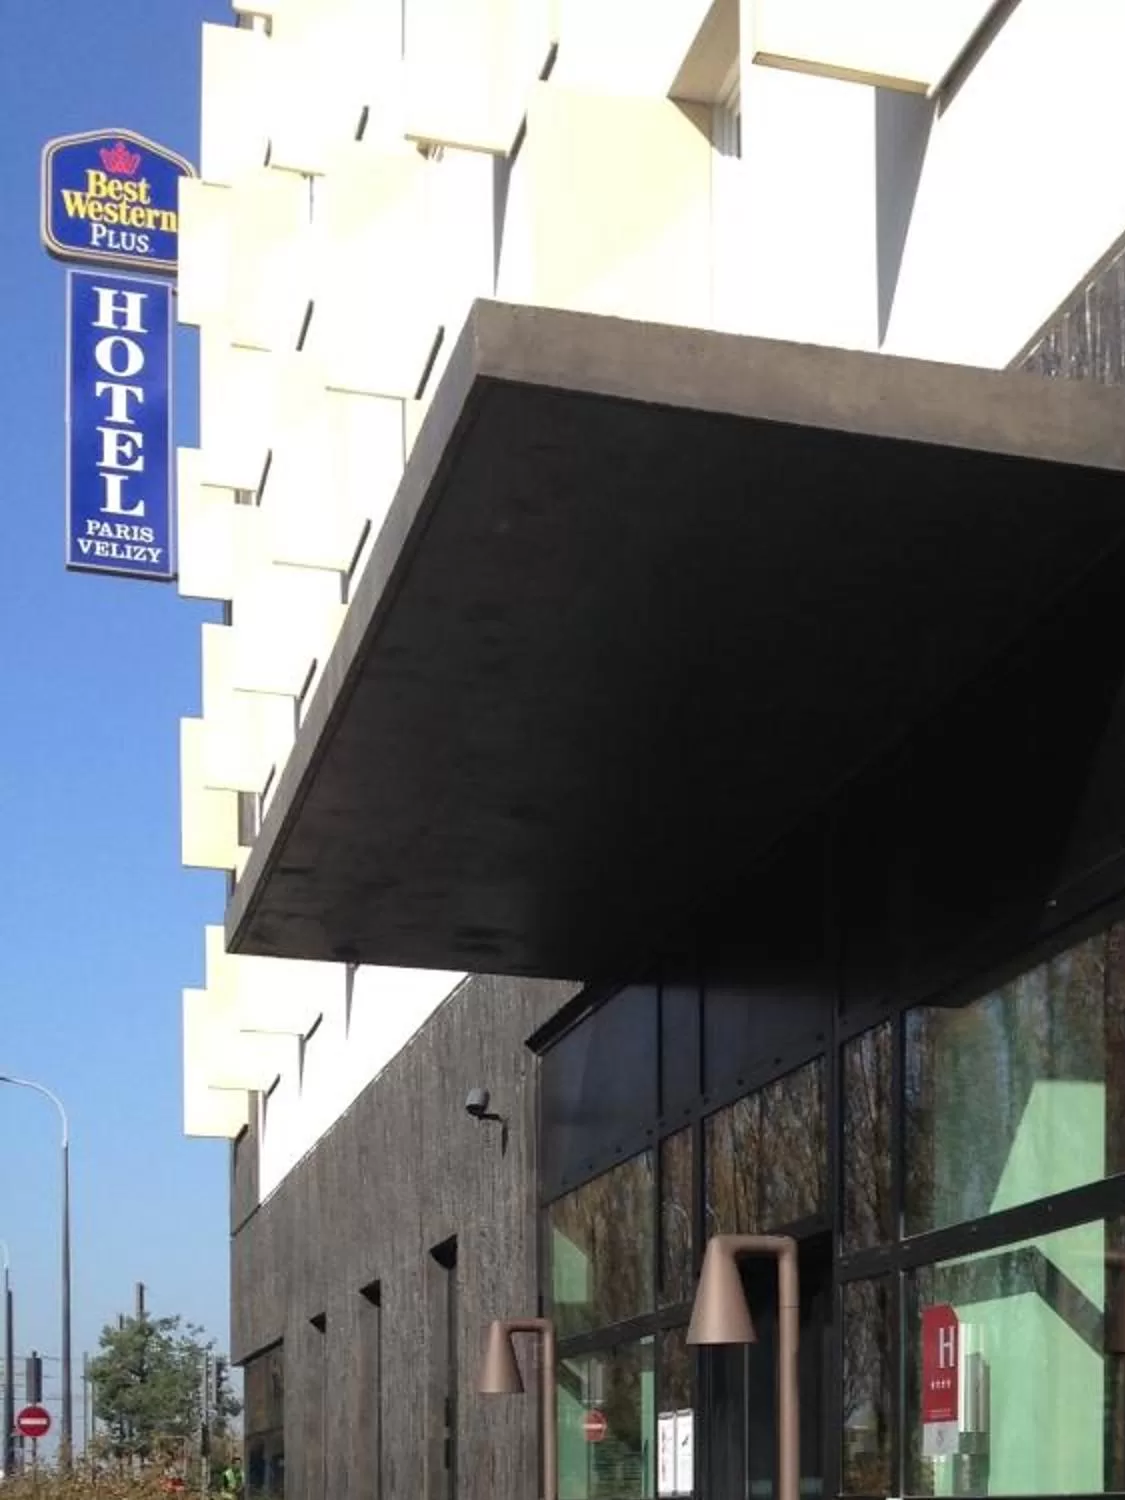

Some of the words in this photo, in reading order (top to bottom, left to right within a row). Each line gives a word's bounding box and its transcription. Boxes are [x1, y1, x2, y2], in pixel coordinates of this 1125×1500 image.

[86, 169, 150, 204] Best
[61, 189, 178, 233] Western
[90, 223, 150, 252] PLUS
[91, 286, 149, 517] HOTEL
[86, 519, 155, 543] PARIS
[77, 538, 163, 563] VELIZY
[938, 1325, 956, 1369] H
